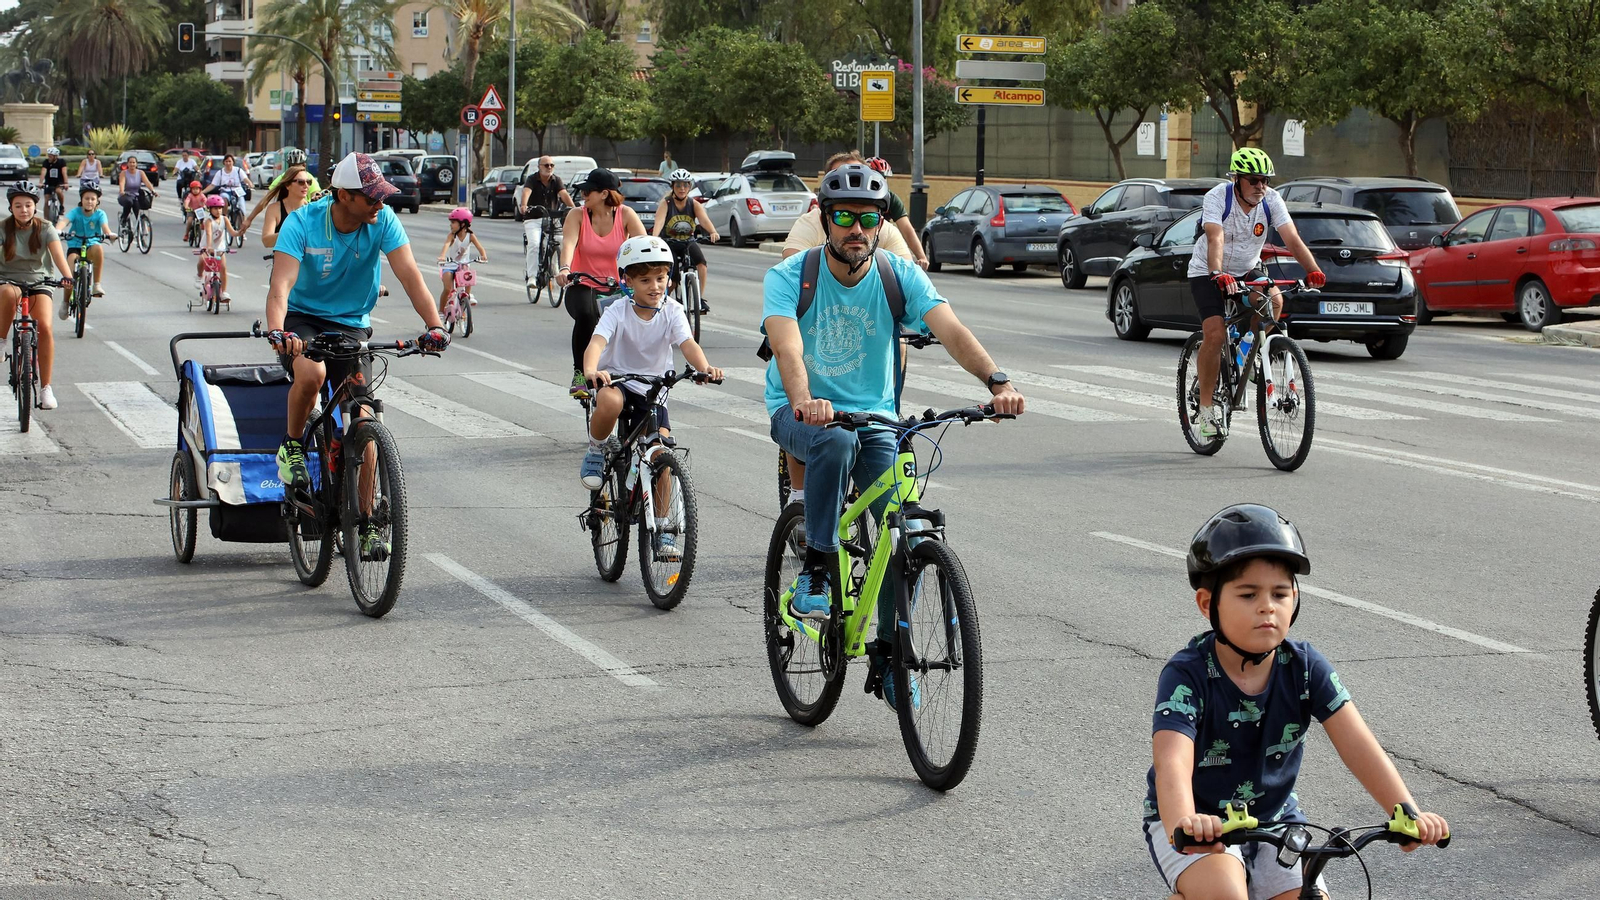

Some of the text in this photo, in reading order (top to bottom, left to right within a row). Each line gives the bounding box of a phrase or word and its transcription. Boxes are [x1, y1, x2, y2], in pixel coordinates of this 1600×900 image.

[832, 59, 895, 73] Restaurante
[835, 72, 847, 87] El
[993, 90, 1042, 102] Alcampo
[484, 118, 497, 126] 30
[1326, 302, 1371, 314] 0675 JML
[260, 479, 285, 488] ebik
